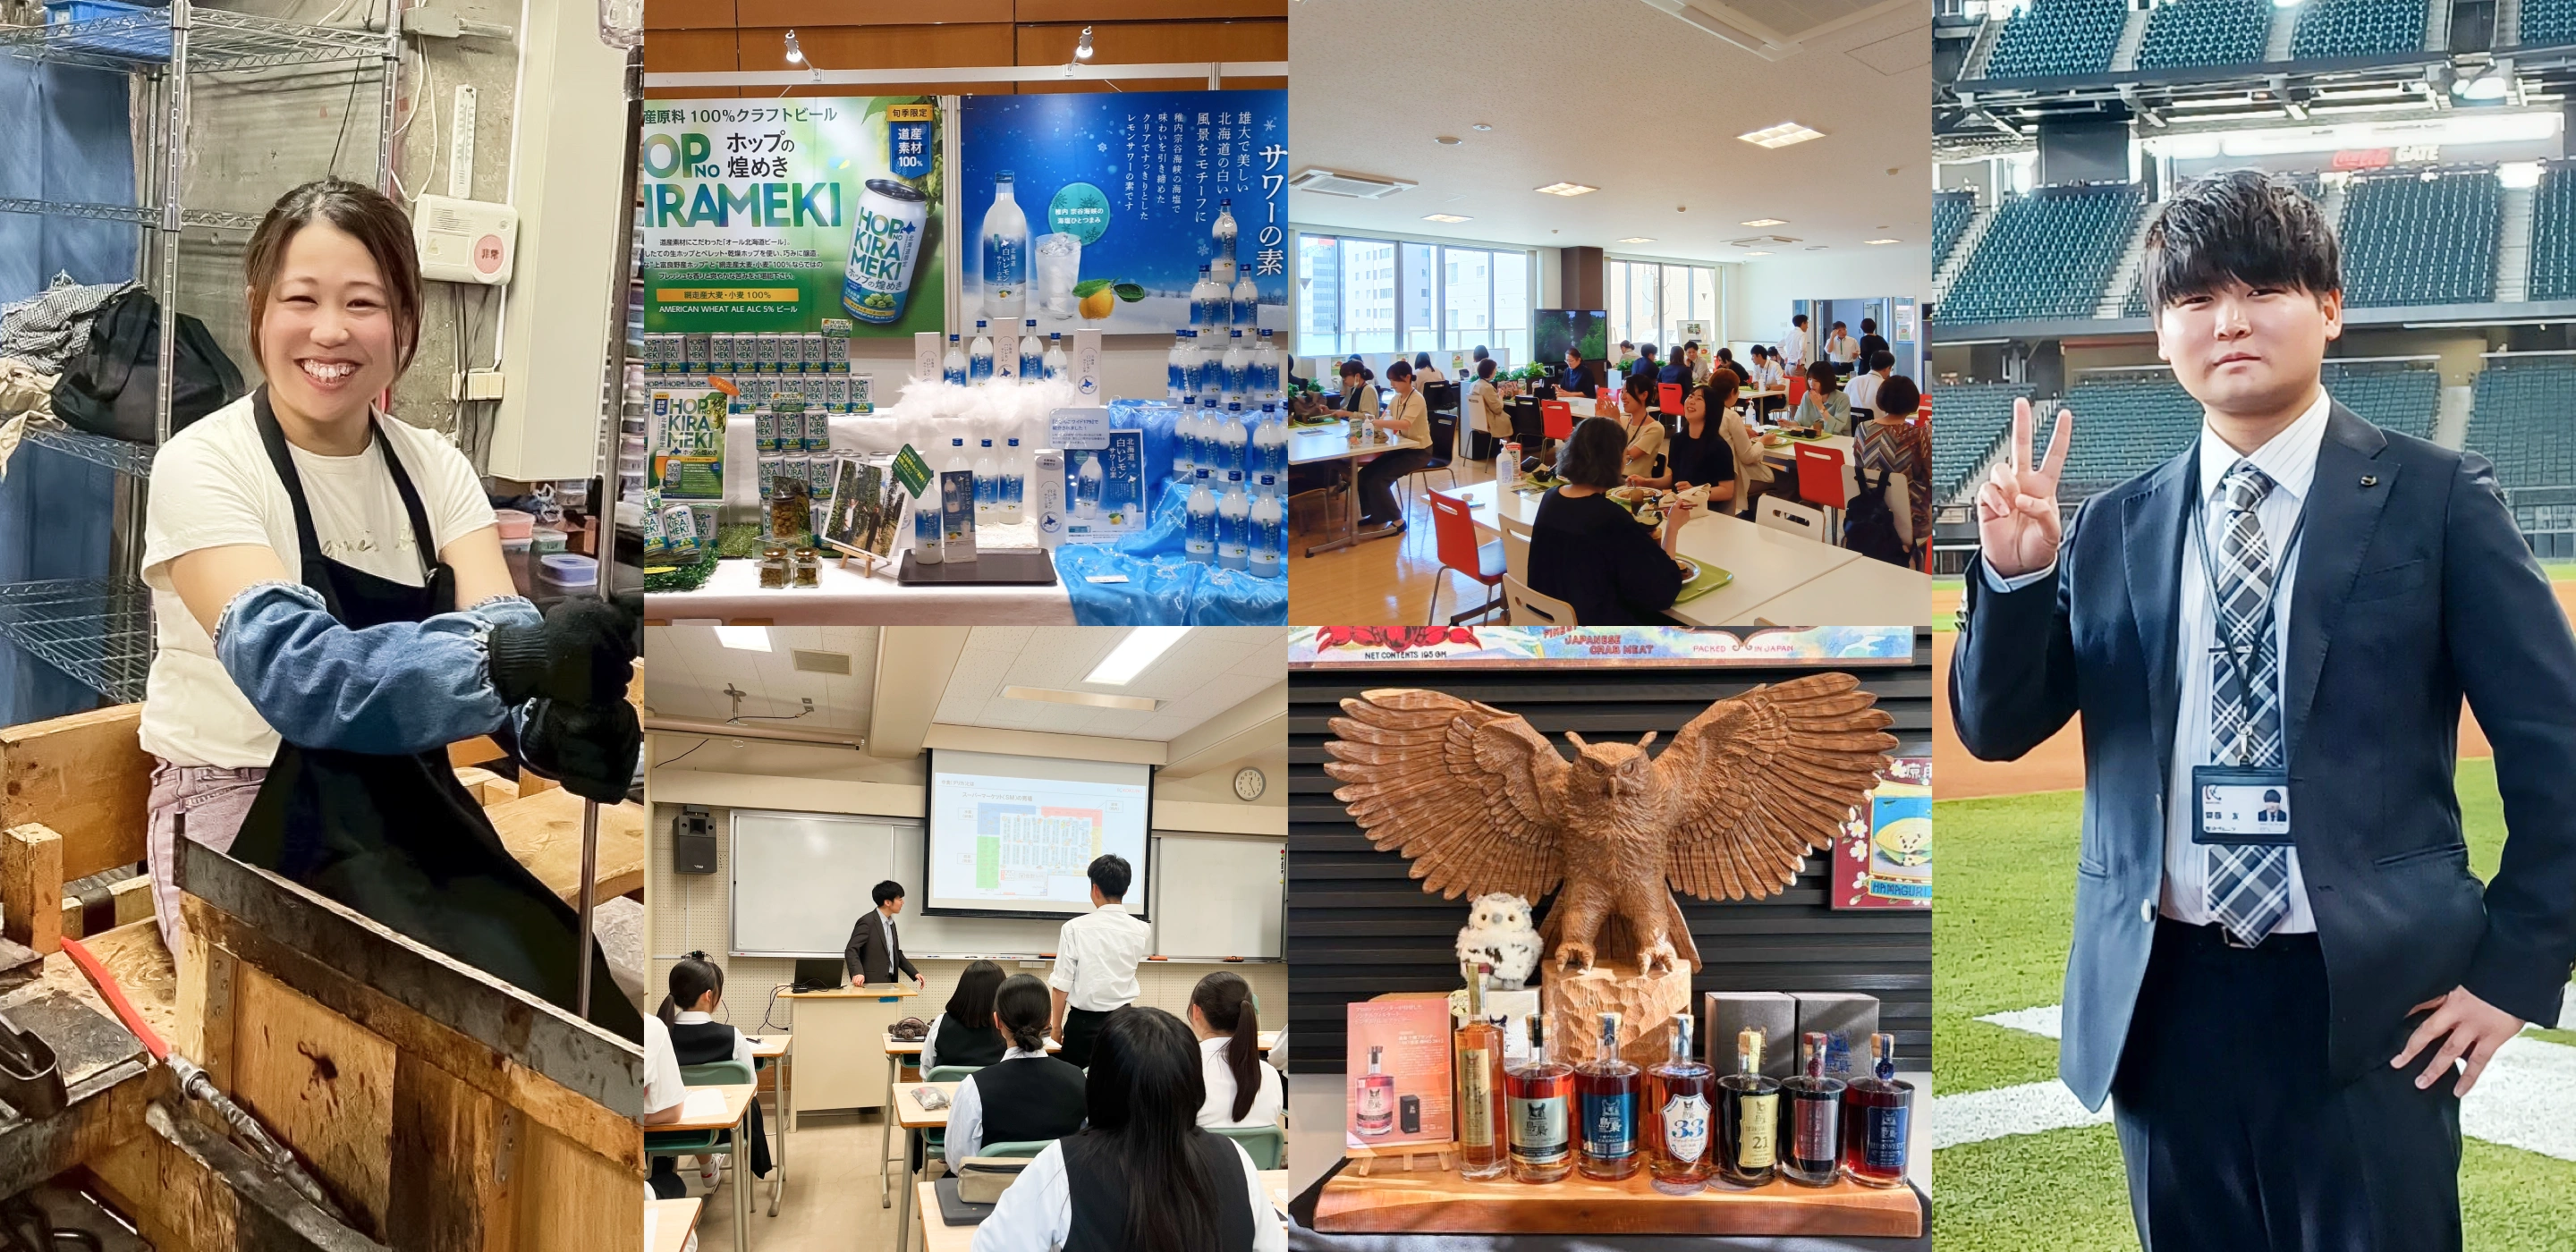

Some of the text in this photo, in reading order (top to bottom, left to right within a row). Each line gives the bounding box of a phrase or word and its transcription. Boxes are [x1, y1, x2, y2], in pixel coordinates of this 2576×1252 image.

[691, 107, 838, 123] 100%クラフトビール
[892, 108, 928, 118] 旬季限定
[726, 130, 794, 153] ホップの
[897, 128, 923, 140] 道産
[897, 141, 923, 155] 素材
[1157, 112, 1168, 204] 味わいを引き締めた
[1216, 112, 1232, 195] 北海道の白い
[1236, 111, 1252, 193] 雄大で美しい
[2395, 145, 2440, 163] GATE
[695, 164, 720, 178] NO
[727, 156, 788, 178] 煌めき
[897, 156, 923, 167] 100%
[1124, 114, 1136, 212] レモンサワーの素です
[1140, 113, 1151, 221] クリアですっきりとした
[1172, 112, 1183, 214] 稚内宗谷海峡の海塩で
[1195, 112, 1210, 223] 風景をモチーフに
[1256, 144, 1288, 276] サワーの素
[858, 207, 904, 239] HOP
[854, 227, 901, 261] KIRA
[851, 248, 902, 281] MEKI
[1002, 248, 1010, 283] 白いレモン
[747, 291, 771, 300] 100%
[659, 305, 798, 313] AMERICAN WHEAT ALE ALC 5% ビール
[669, 398, 709, 415] HOP
[669, 415, 711, 432] KIRA
[667, 432, 714, 448] MEKI
[1126, 437, 1135, 461] 北海道
[1109, 447, 1117, 479] サワーの素
[1116, 437, 1127, 479] 白いレモン
[1564, 634, 1621, 645] JAPANESE
[1693, 645, 1726, 653] PACKED
[1764, 645, 1793, 653] JAPAN
[1364, 651, 1379, 660] NET
[1381, 651, 1419, 659] CONTENTS
[1589, 645, 1654, 656] CRAB MEAT
[1672, 1118, 1704, 1138] 33
[1752, 1136, 1769, 1149] 21
